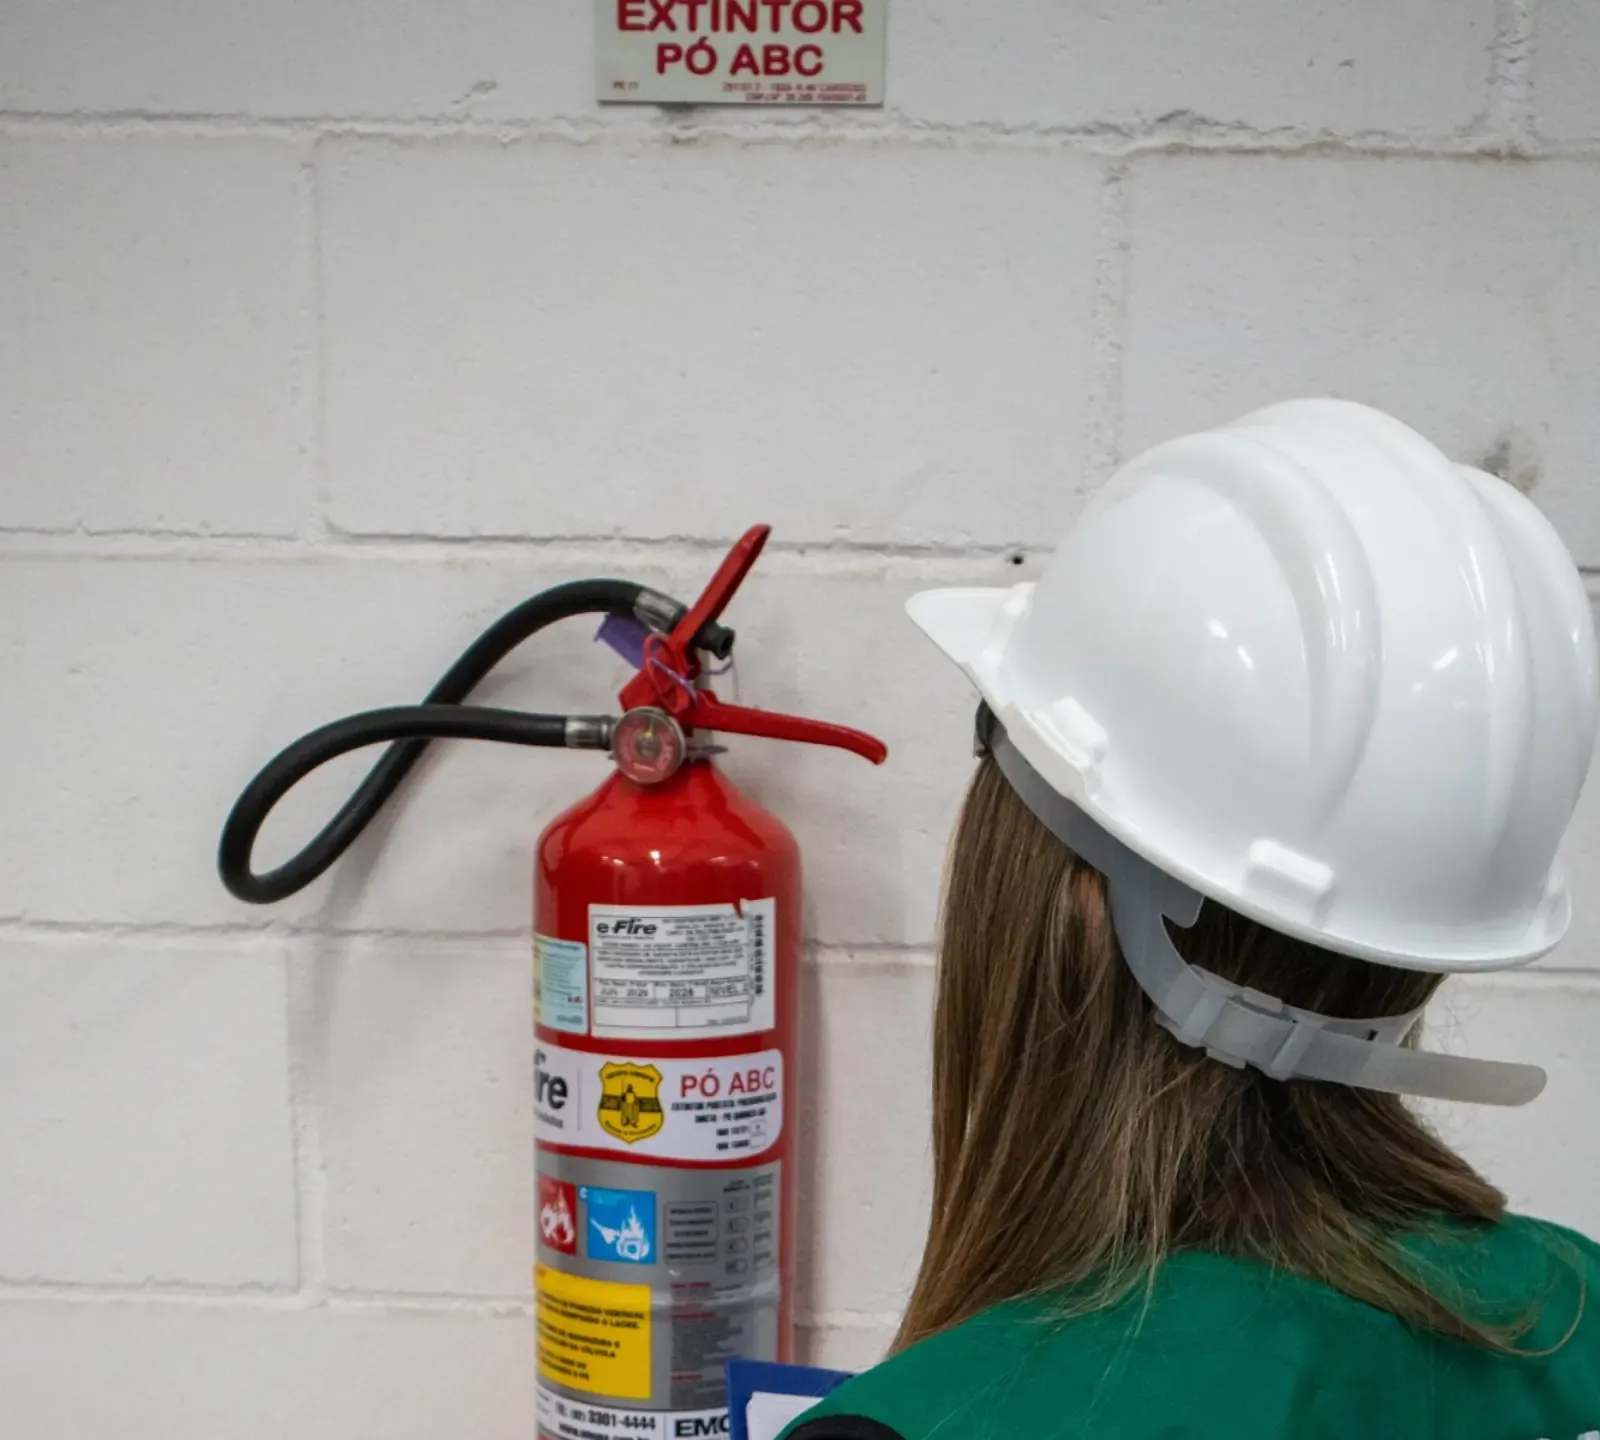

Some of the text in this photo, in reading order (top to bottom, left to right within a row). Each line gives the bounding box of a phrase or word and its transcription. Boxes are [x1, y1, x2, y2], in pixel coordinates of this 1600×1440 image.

[616, 0, 864, 33] EXTINTOR
[656, 36, 824, 76] PÓ ABC
[680, 1068, 720, 1098] PÓ
[728, 1066, 775, 1096] ABC
[588, 1410, 656, 1430] 3301-4444
